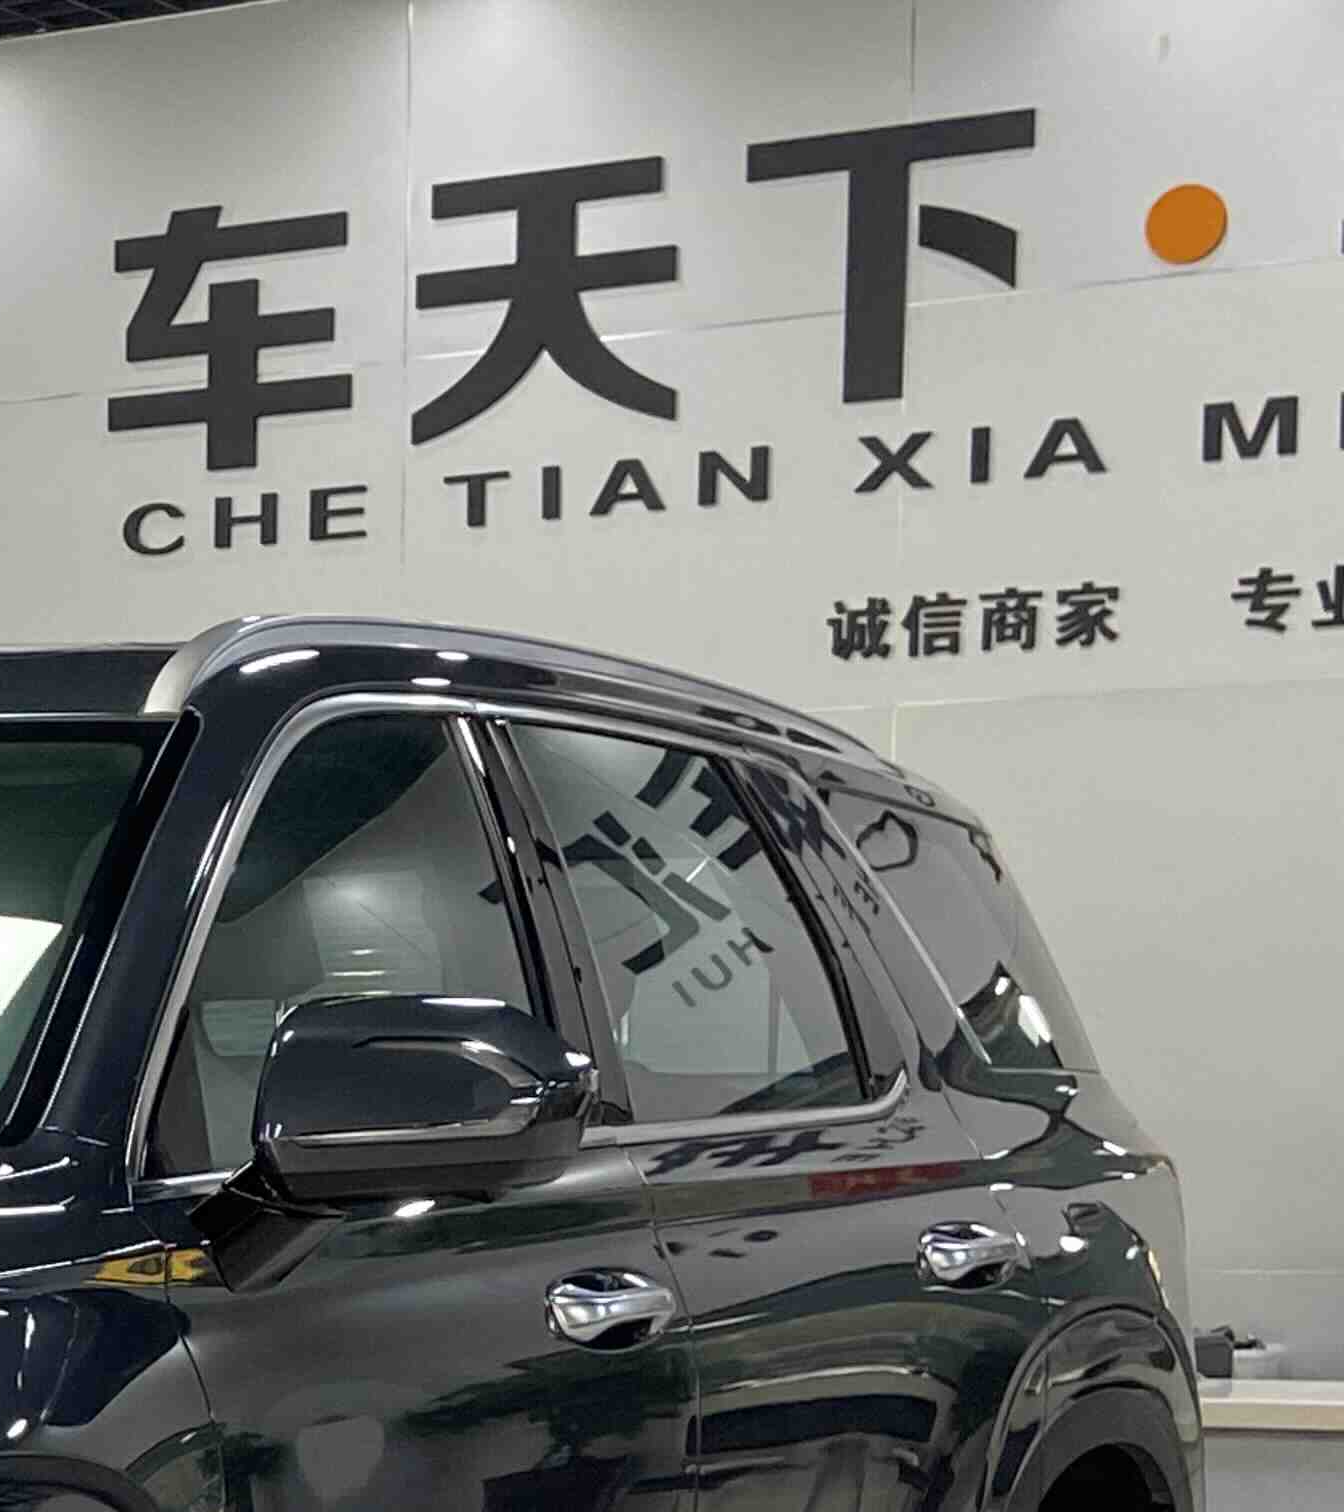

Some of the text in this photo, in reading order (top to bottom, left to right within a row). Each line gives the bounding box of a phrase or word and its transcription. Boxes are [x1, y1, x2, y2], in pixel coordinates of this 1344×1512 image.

[122, 391, 1344, 556] CHE TIAN XIA M
[825, 582, 1122, 661] 诚信商家
